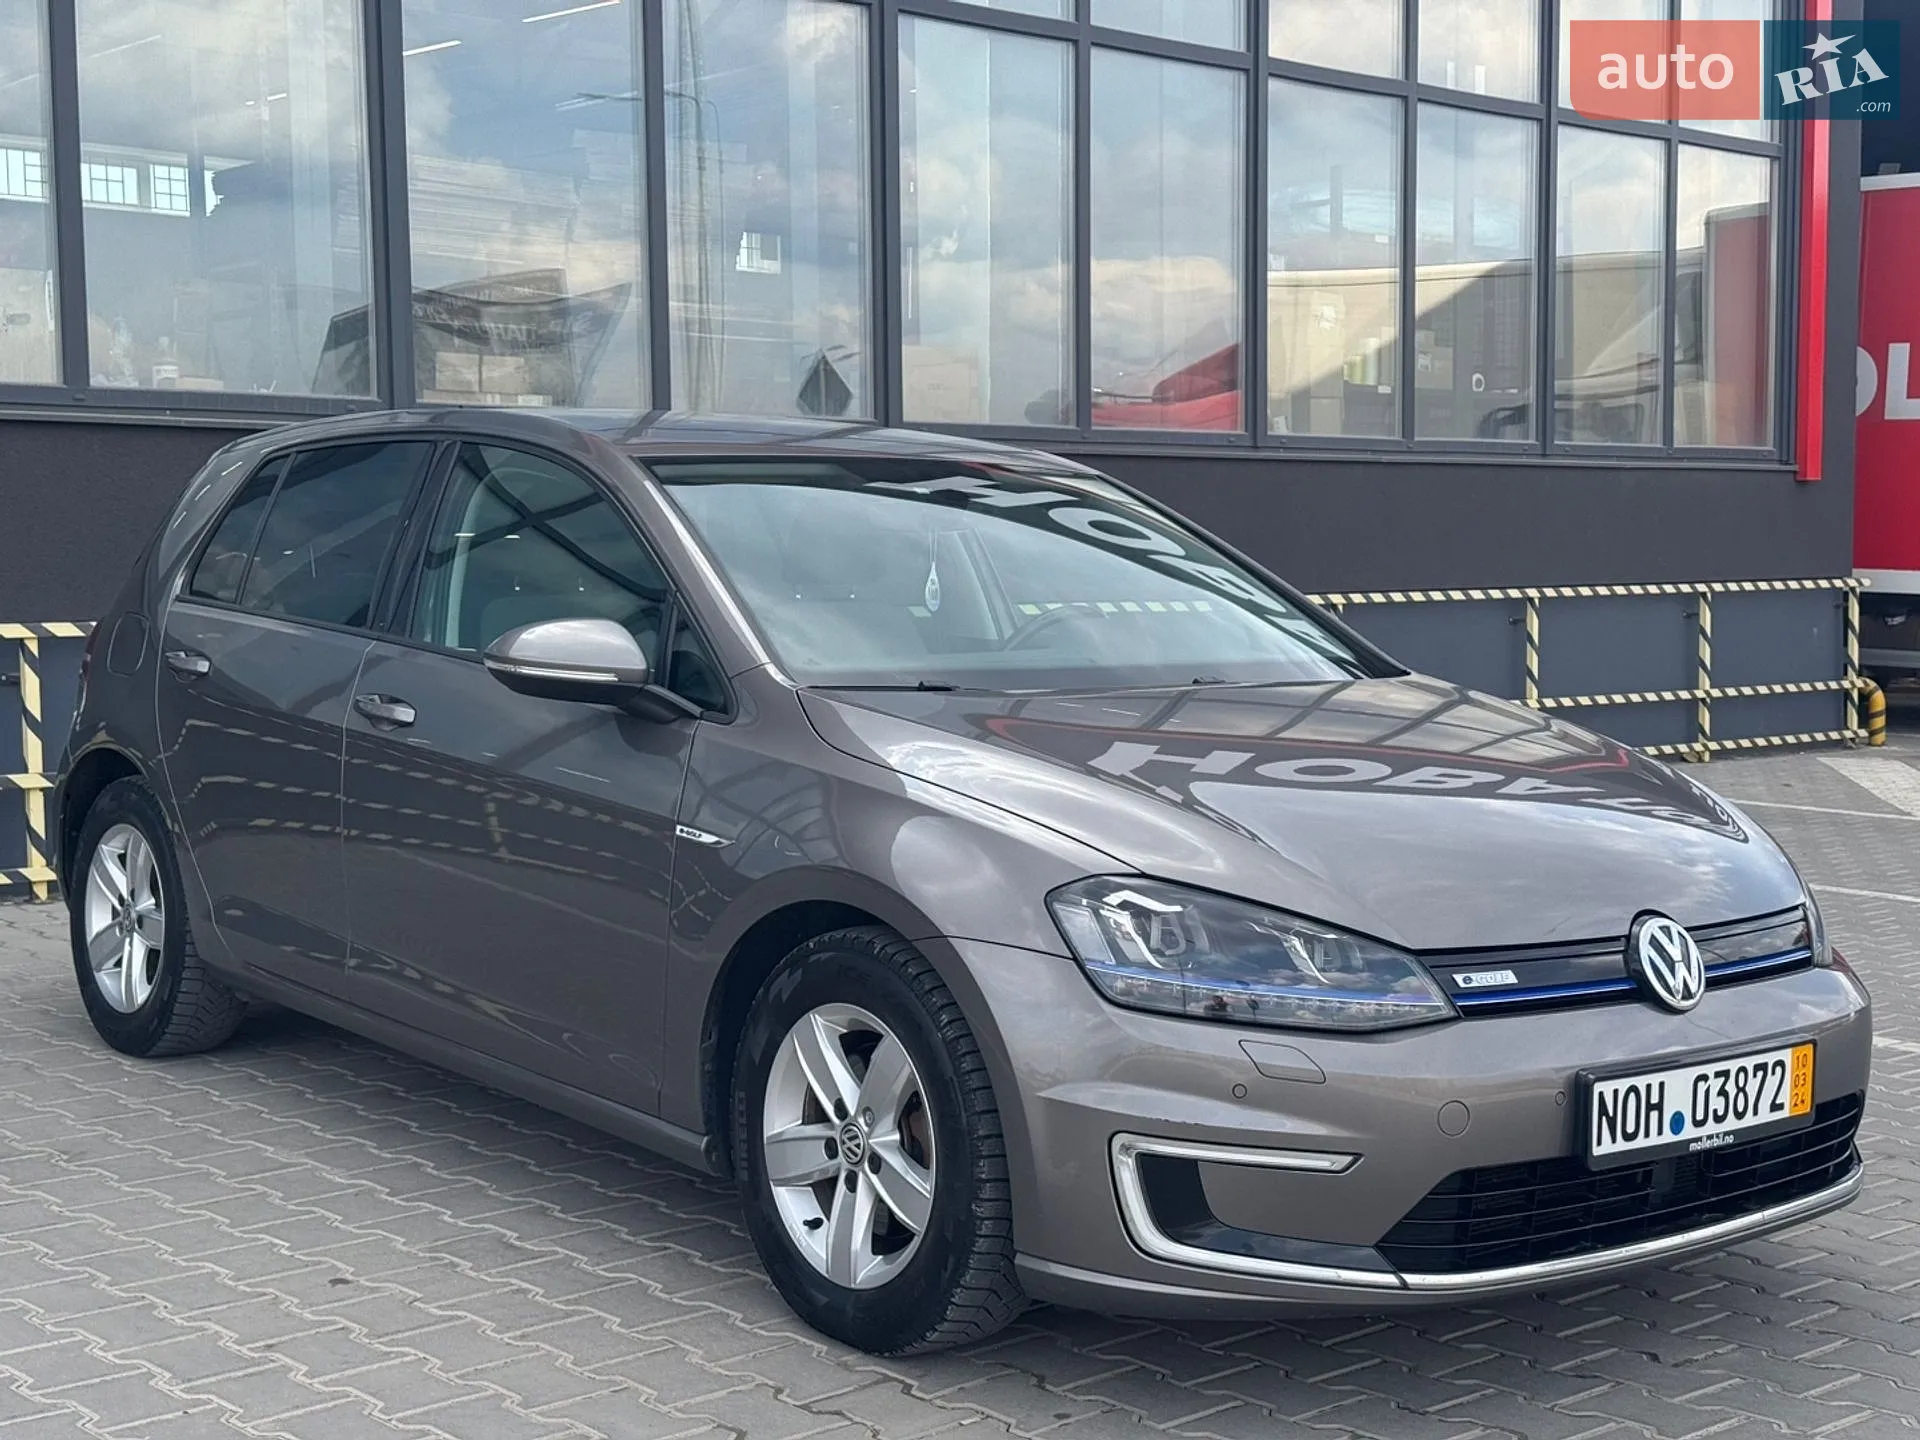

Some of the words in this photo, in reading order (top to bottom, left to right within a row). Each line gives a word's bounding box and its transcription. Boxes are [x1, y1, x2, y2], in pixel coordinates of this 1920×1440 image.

[1795, 1053, 1808, 1069] 10
[1793, 1072, 1807, 1088] 03
[1596, 1081, 1666, 1147] NOH
[1691, 1059, 1787, 1129] 03872
